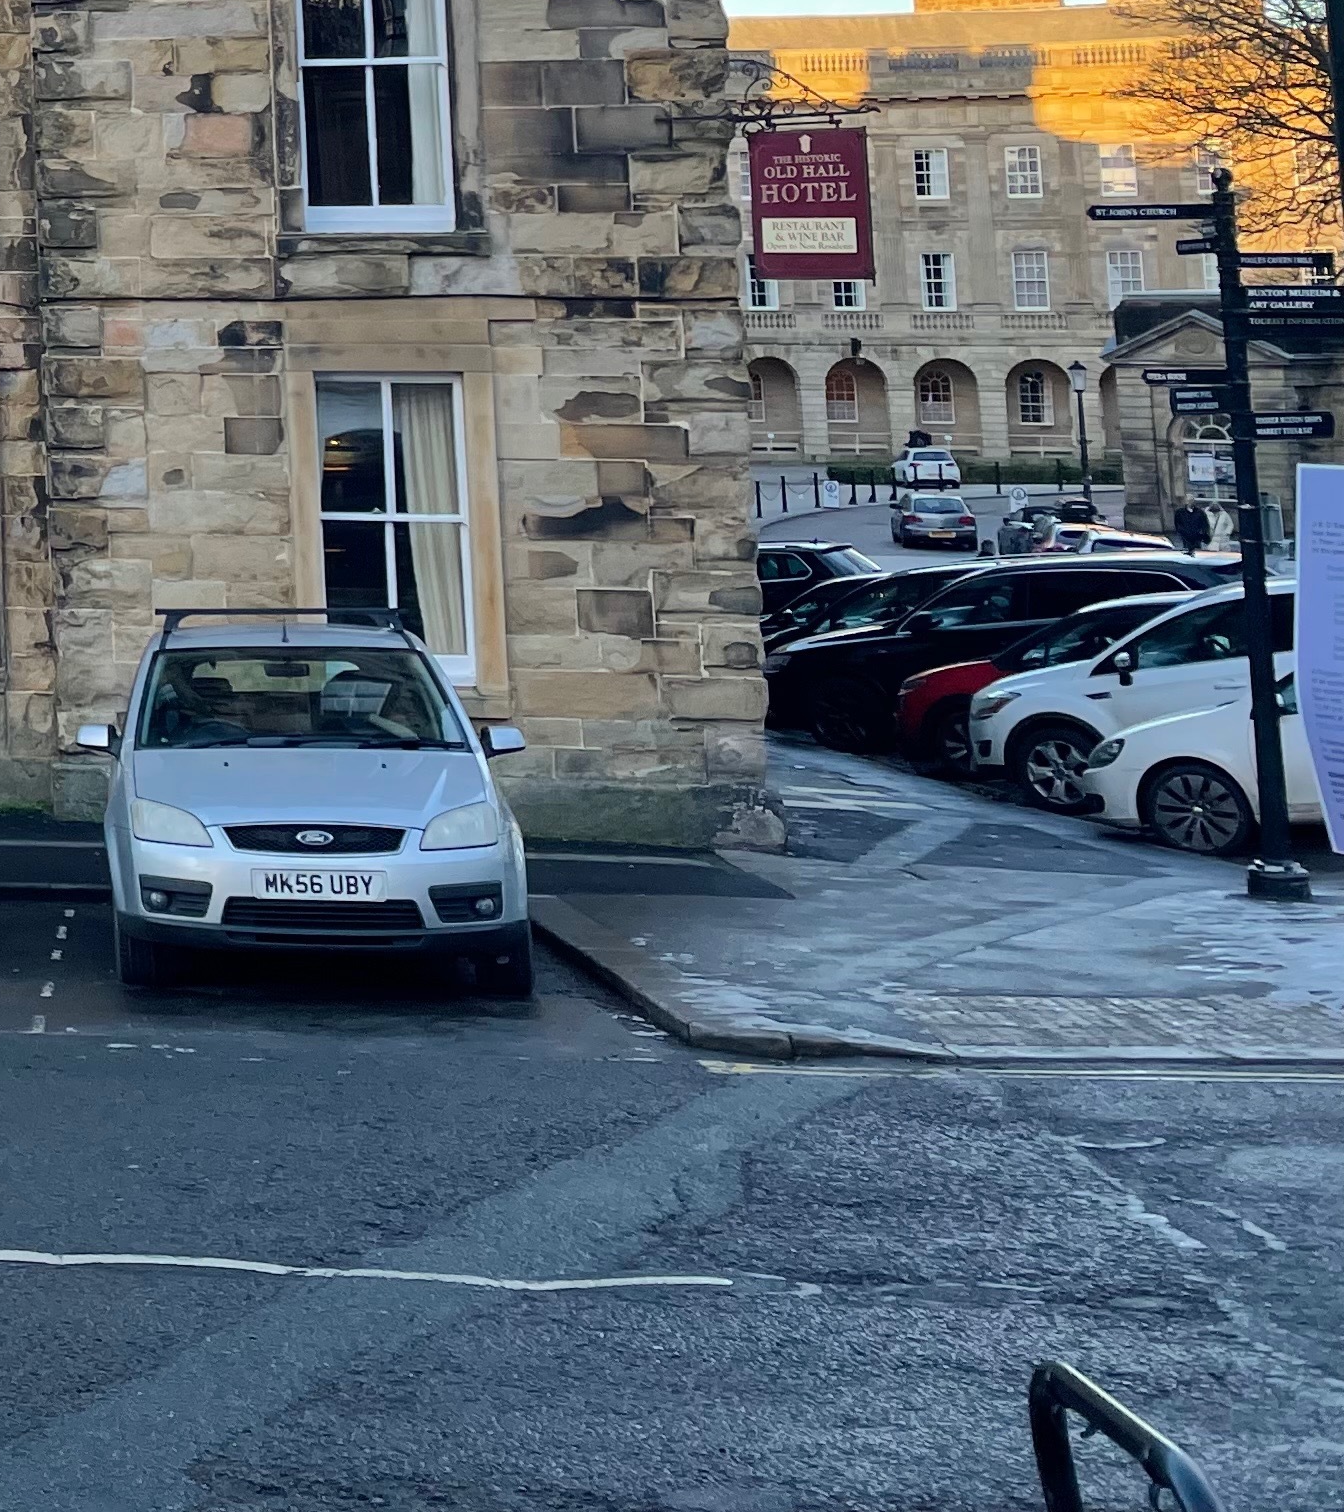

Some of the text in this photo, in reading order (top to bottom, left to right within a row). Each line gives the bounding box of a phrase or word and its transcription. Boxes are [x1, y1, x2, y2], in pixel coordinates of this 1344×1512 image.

[772, 153, 842, 165] THE HISTORIC
[763, 163, 851, 179] OLD HALL
[760, 181, 858, 204] HOTEL
[1139, 208, 1177, 216] CHURCH
[772, 220, 847, 231] RESTAURANT
[775, 232, 845, 242] & WINE BAR
[1247, 289, 1342, 297] BUXTON MUSEUM &
[1249, 301, 1315, 309] ART GALLERY
[264, 872, 373, 896] MK56 UBY
